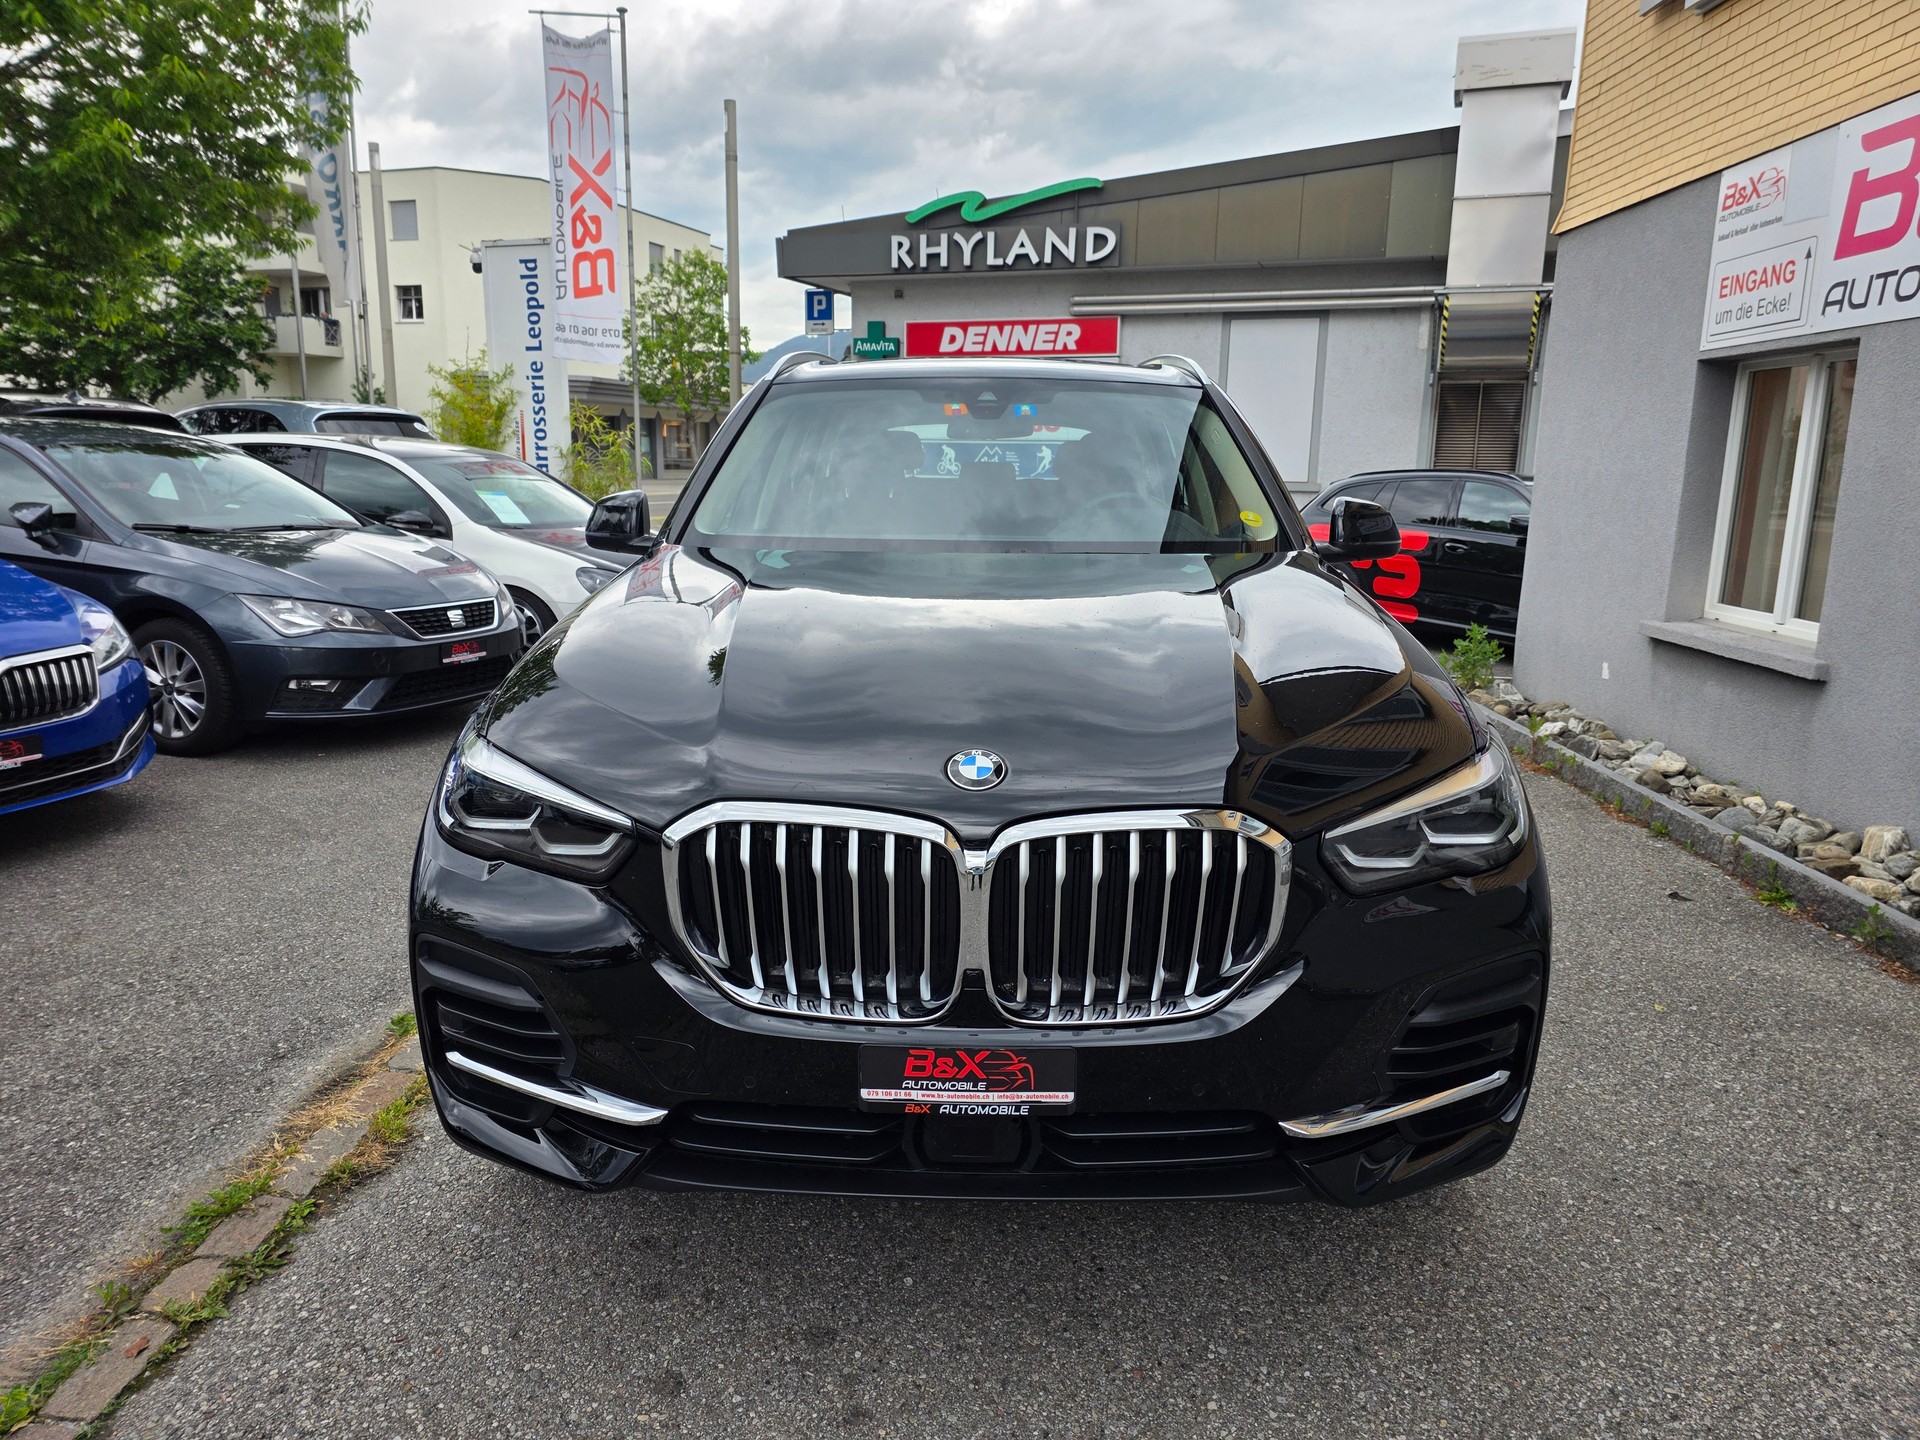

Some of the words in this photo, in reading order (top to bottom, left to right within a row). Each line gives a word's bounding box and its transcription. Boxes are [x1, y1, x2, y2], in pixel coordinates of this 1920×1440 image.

[1721, 171, 1766, 212] B&X
[1833, 114, 1920, 262] B
[1719, 202, 1761, 223] AUTOMOBILE
[891, 226, 1117, 269] RHYLAND
[1719, 259, 1796, 299] EINGANG
[519, 258, 545, 352] Leopold
[813, 295, 826, 318] P
[1715, 308, 1732, 325] um
[1735, 302, 1753, 321] die
[1756, 292, 1792, 317] Ecke!
[939, 323, 1081, 353] DENNER
[526, 361, 550, 474] arrosserie
[903, 1049, 992, 1078] B&X
[902, 1081, 987, 1091] AUTOMOBILE
[920, 1092, 990, 1100] www.bx-automobile.ch
[904, 1104, 932, 1114] B&X
[939, 1104, 1030, 1115] AUTOMOBILE
